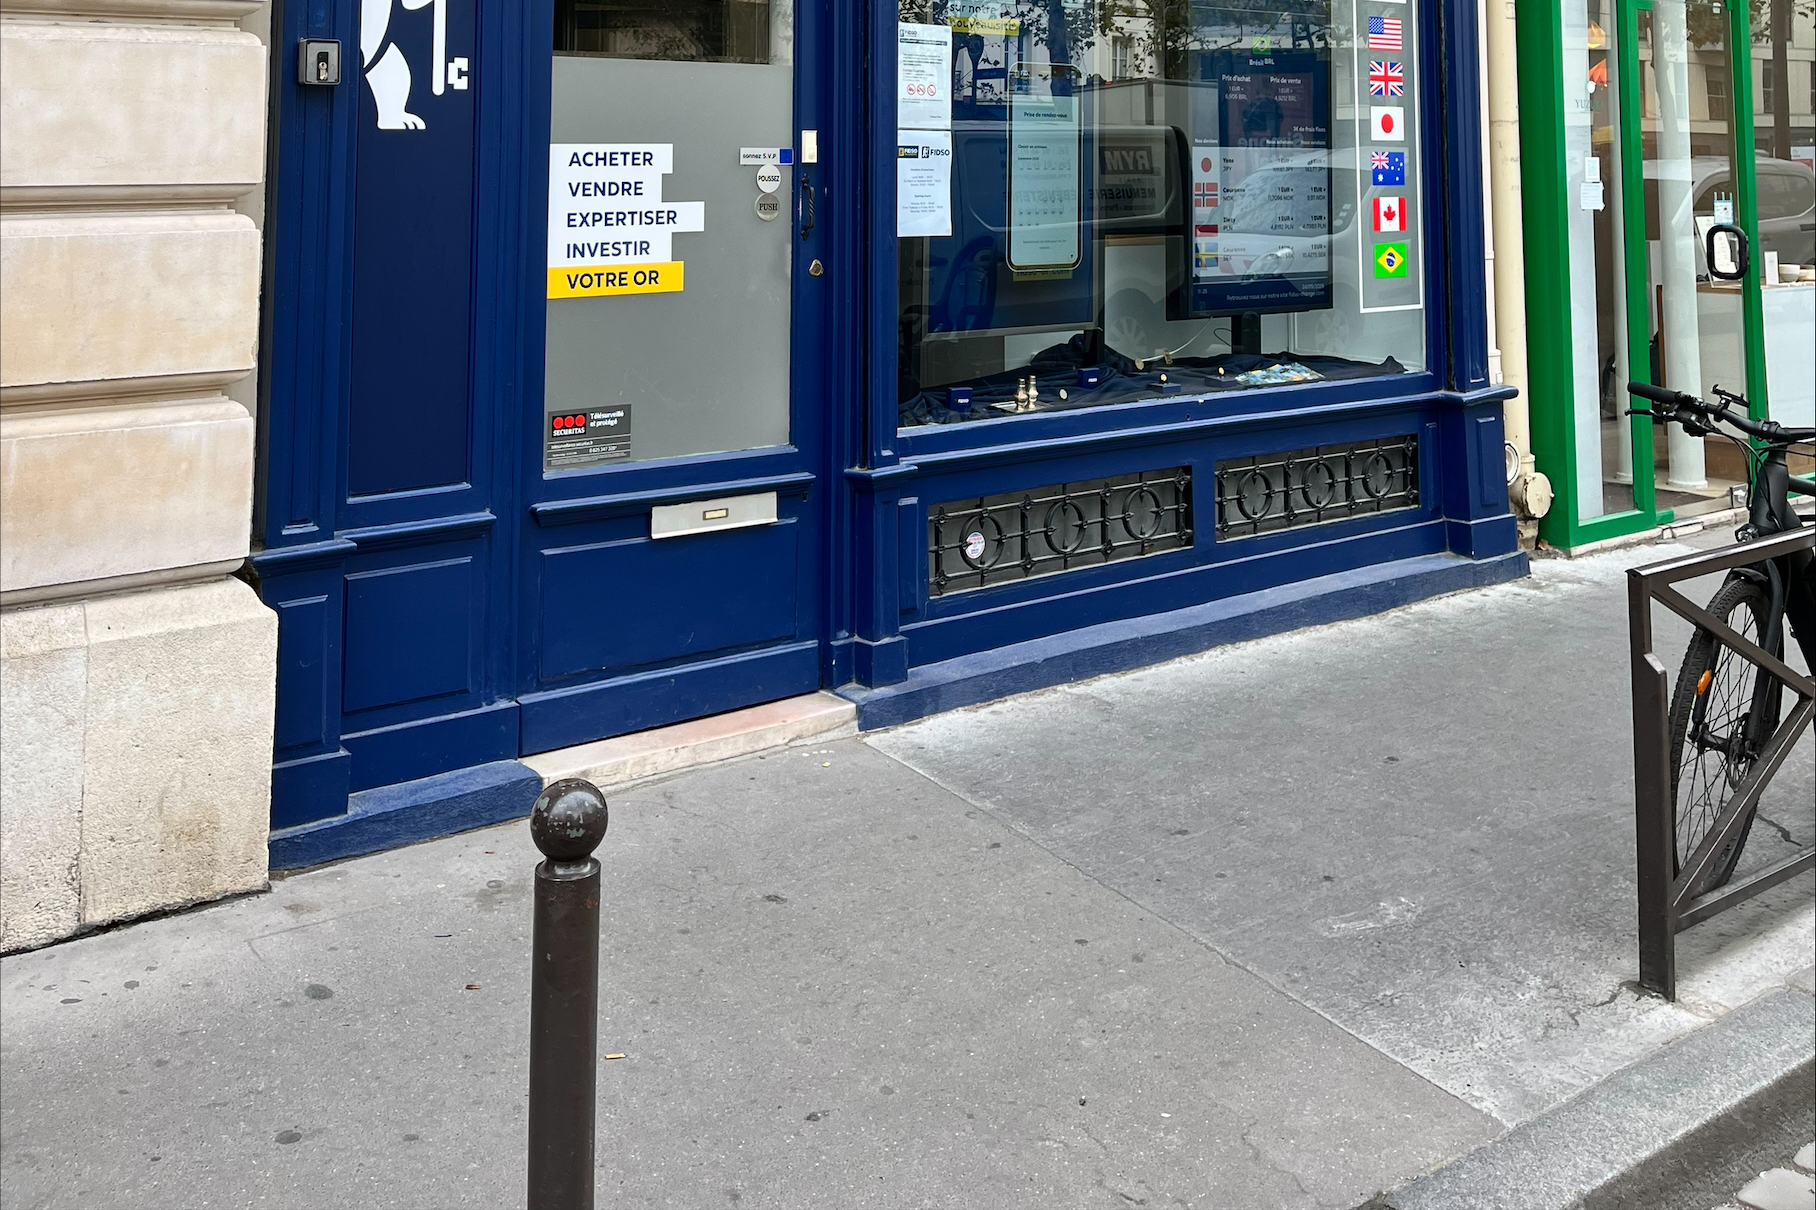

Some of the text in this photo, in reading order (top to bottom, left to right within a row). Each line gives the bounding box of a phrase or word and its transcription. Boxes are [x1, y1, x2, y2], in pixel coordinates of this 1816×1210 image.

[950, 3, 996, 14] sur notre
[568, 151, 654, 167] ACHETER
[568, 181, 644, 197] VENDRE
[759, 203, 778, 211] PUSH
[567, 210, 677, 228] EXPERTISER
[566, 240, 650, 259] INVESTIR
[566, 270, 660, 290] VOTRE OR
[553, 427, 585, 437] SECURITAS
